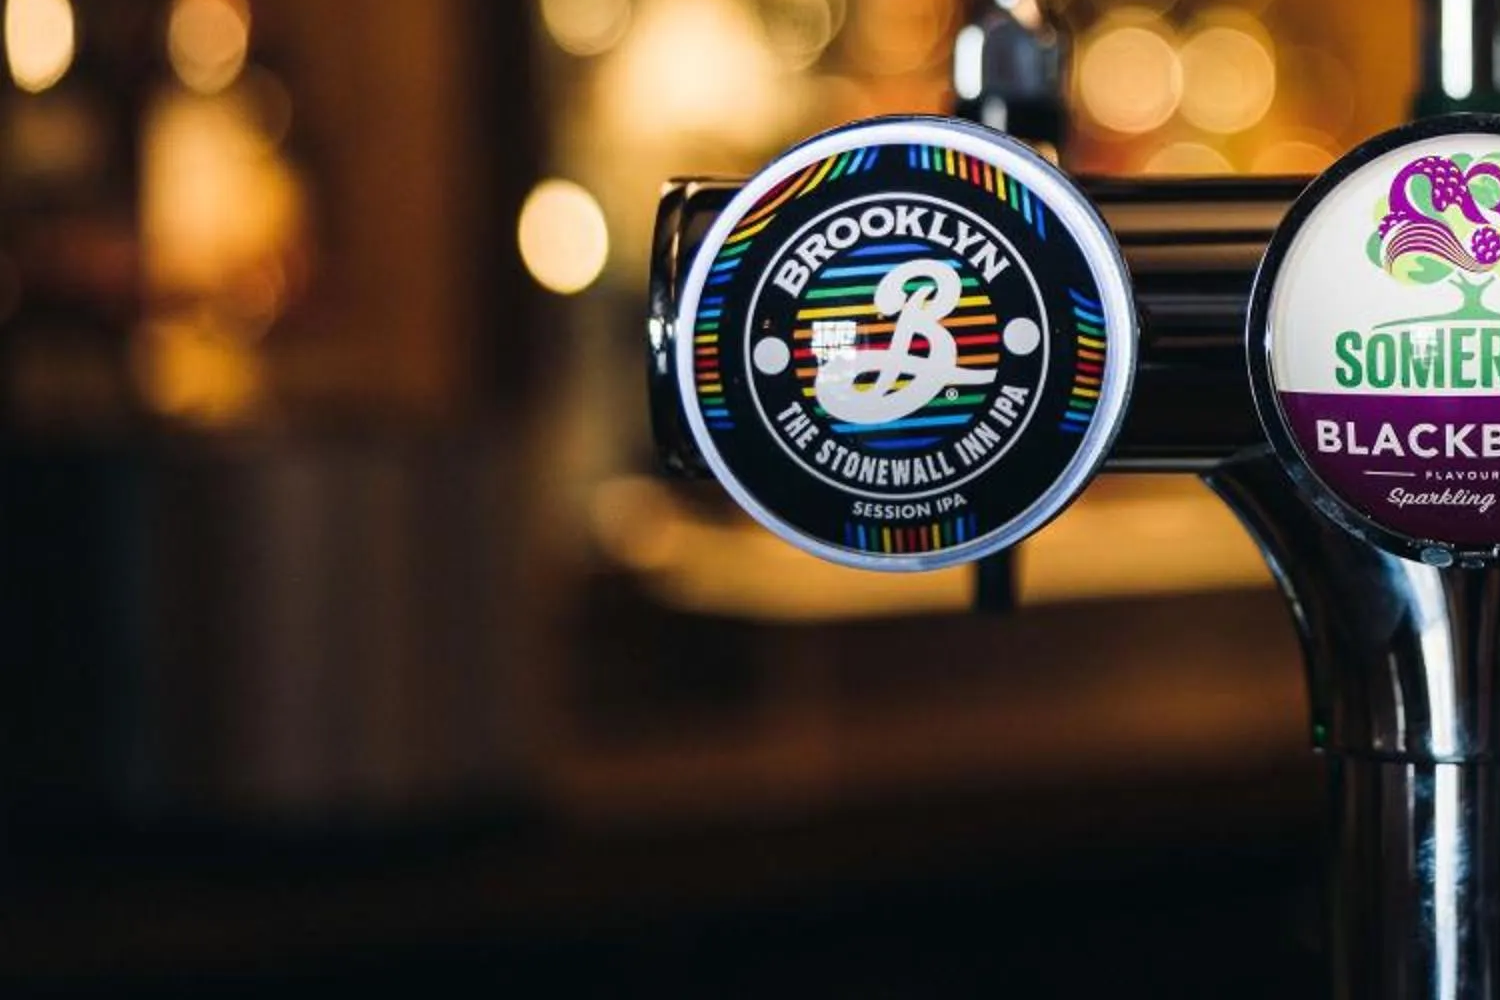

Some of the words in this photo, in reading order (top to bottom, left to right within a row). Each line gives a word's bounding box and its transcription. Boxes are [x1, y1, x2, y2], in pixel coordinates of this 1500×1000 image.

[773, 205, 1010, 298] BROOKLYN
[777, 401, 820, 450] THE
[815, 439, 955, 486] STONEWALL
[954, 422, 1001, 466] INN
[988, 384, 1029, 427] IPA
[852, 501, 930, 519] SESSION
[937, 493, 967, 512] IPA
[1387, 487, 1497, 513] Sparkling
